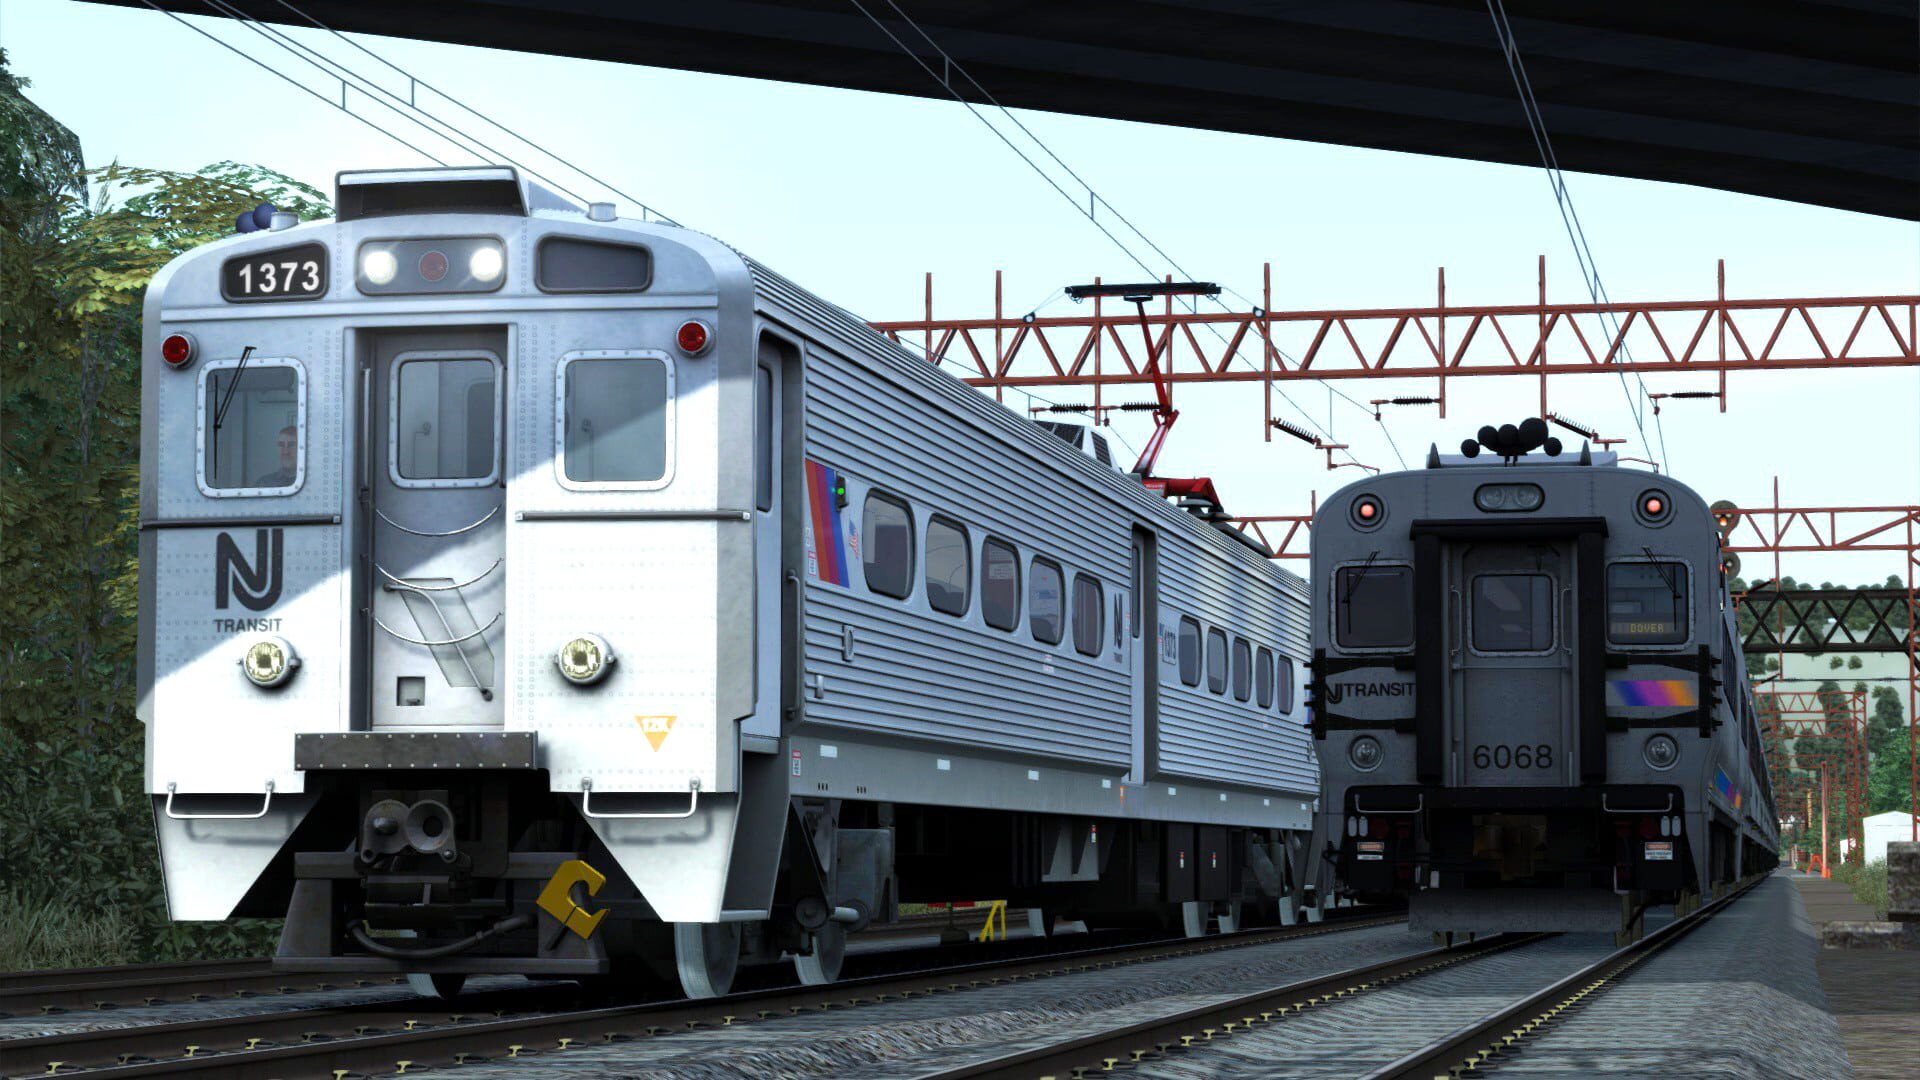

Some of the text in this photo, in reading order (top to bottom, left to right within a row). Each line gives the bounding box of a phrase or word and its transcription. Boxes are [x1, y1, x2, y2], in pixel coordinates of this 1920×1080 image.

[240, 261, 320, 294] 1373
[215, 528, 283, 611] NJ
[213, 618, 283, 633] TRANSIT
[1630, 623, 1664, 633] DOVER
[1344, 682, 1417, 697] TRANSIT
[1474, 744, 1553, 769] 6068
